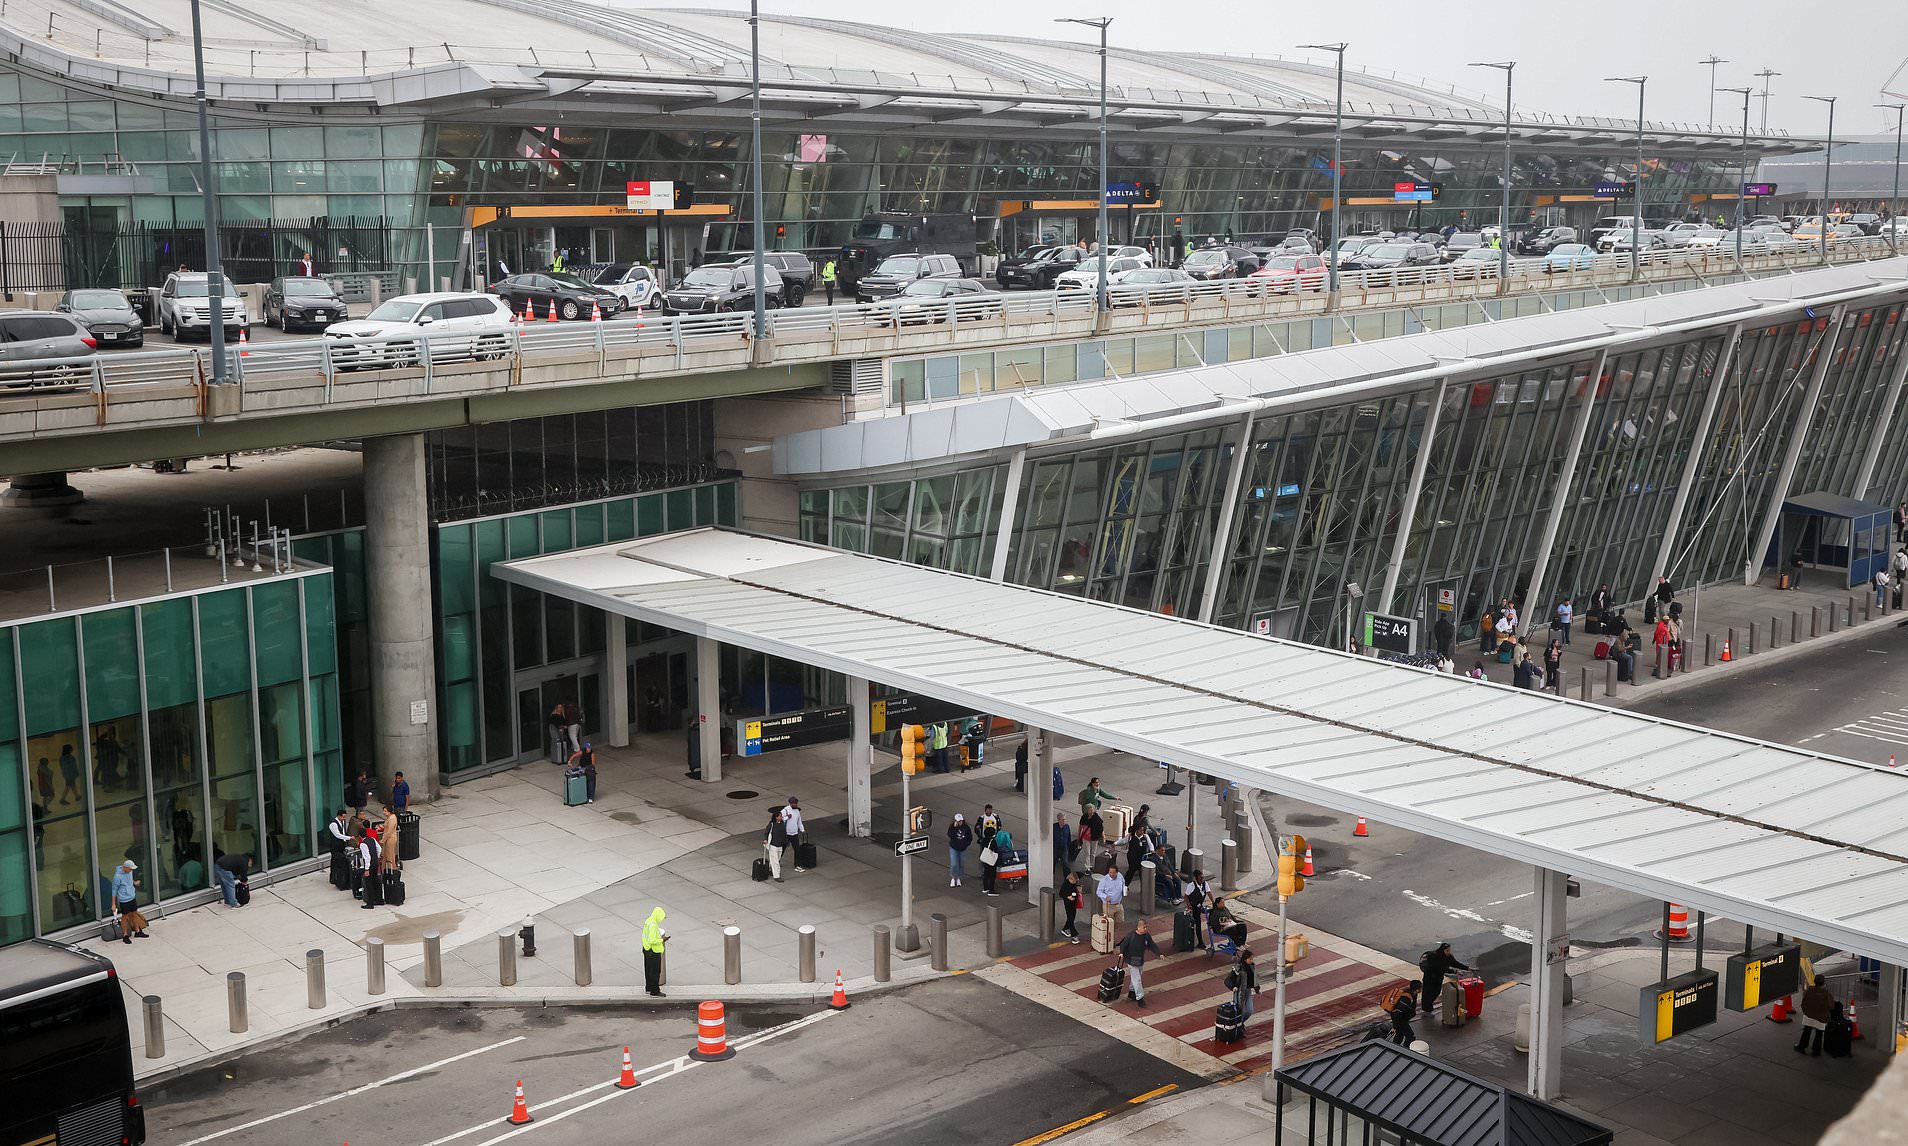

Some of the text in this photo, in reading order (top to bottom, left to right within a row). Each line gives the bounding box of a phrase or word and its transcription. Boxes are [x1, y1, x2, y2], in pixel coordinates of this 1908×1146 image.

[675, 189, 681, 200] F
[1145, 189, 1151, 198] E
[1391, 623, 1408, 637] A4
[1675, 987, 1695, 998] Terminals
